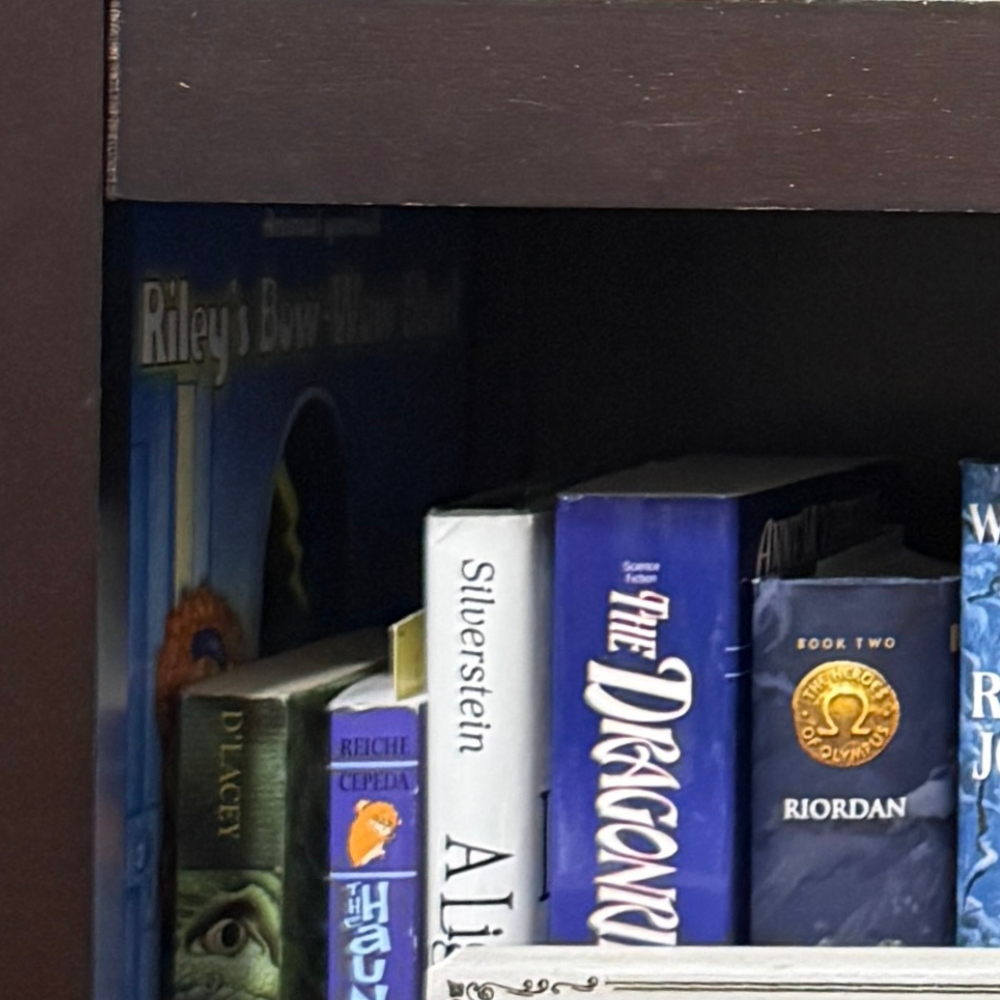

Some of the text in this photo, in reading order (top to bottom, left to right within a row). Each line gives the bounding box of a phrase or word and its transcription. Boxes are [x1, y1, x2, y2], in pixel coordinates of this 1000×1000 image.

[141, 276, 249, 389] Riley's
[459, 558, 495, 753] Silverstein
[797, 637, 896, 650] BOOK TWO
[802, 667, 890, 762] THE HEROES OF OLYMPUS
[218, 710, 243, 838] D'LACEY
[339, 771, 410, 792] CEPEDA
[583, 589, 692, 945] THE DRAGONRI
[783, 797, 907, 820] RIORDAN
[445, 833, 514, 882] A
